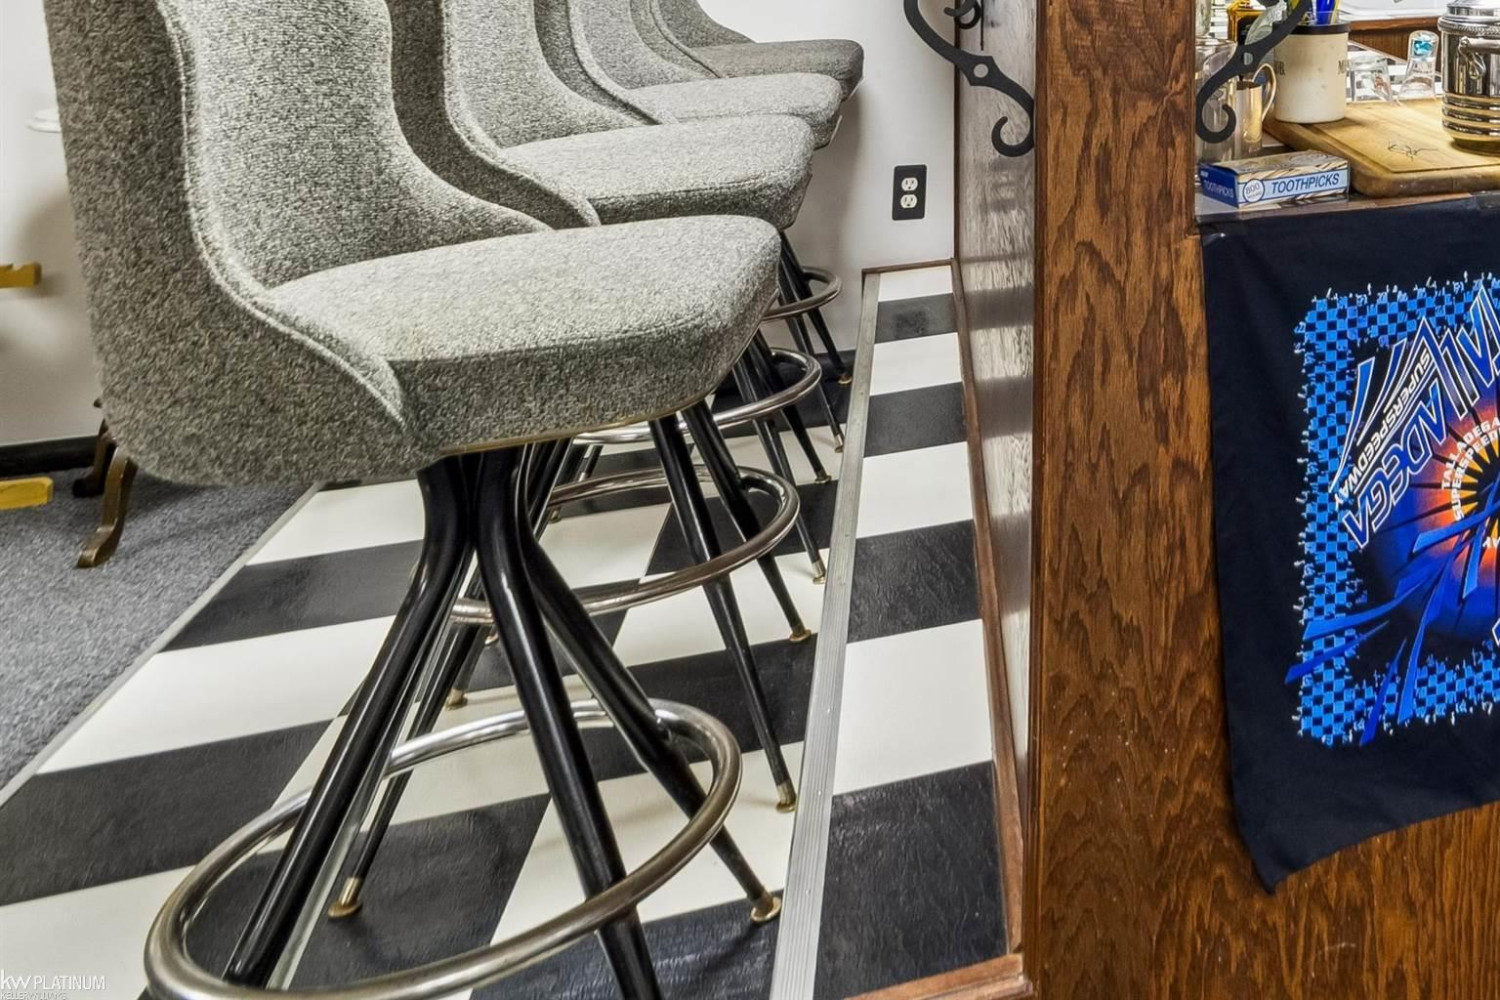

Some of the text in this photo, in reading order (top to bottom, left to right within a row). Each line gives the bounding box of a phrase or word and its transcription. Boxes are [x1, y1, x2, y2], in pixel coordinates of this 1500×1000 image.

[1245, 182, 1261, 194] 800
[1271, 173, 1340, 194] TOOTHPICKS
[1335, 347, 1431, 511] SUPERSPEEDWAY
[1441, 416, 1500, 490] TALLADEGA
